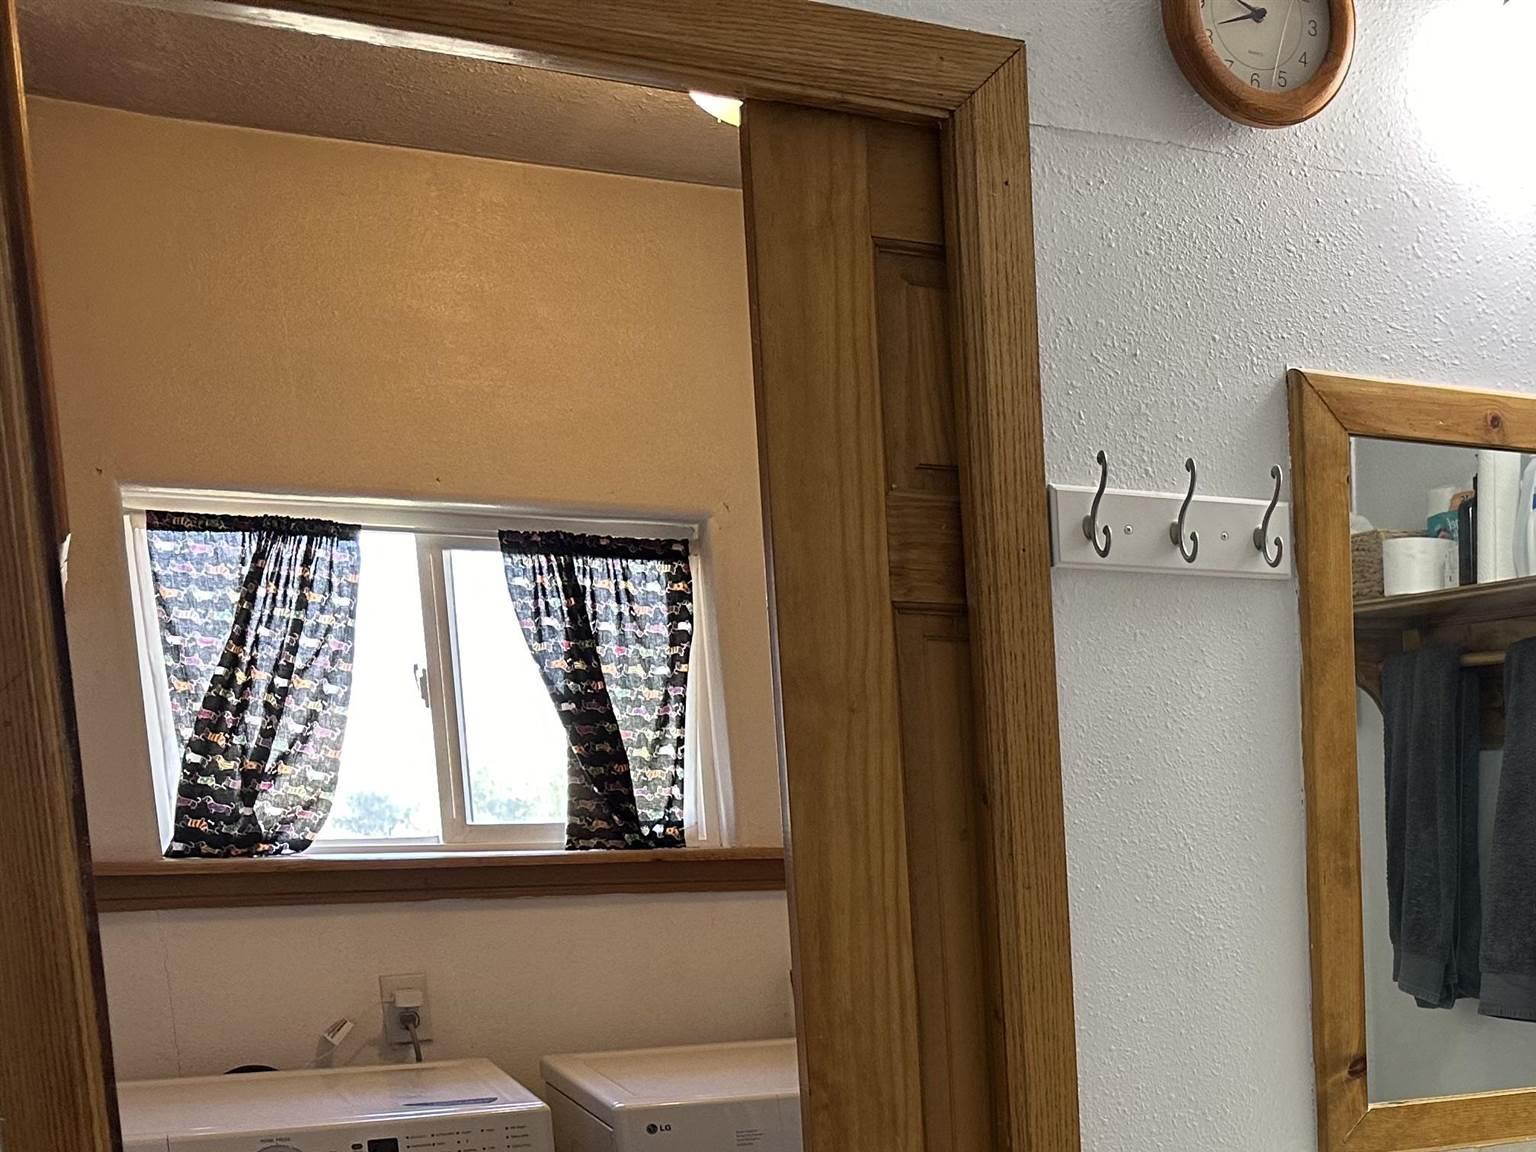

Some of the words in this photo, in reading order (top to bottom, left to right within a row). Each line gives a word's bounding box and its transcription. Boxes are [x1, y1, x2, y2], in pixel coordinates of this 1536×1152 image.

[1308, 19, 1318, 37] 3
[1298, 51, 1308, 68] 4
[1250, 73, 1260, 88] 6
[1278, 70, 1287, 88] 5
[659, 1124, 672, 1132] LG
